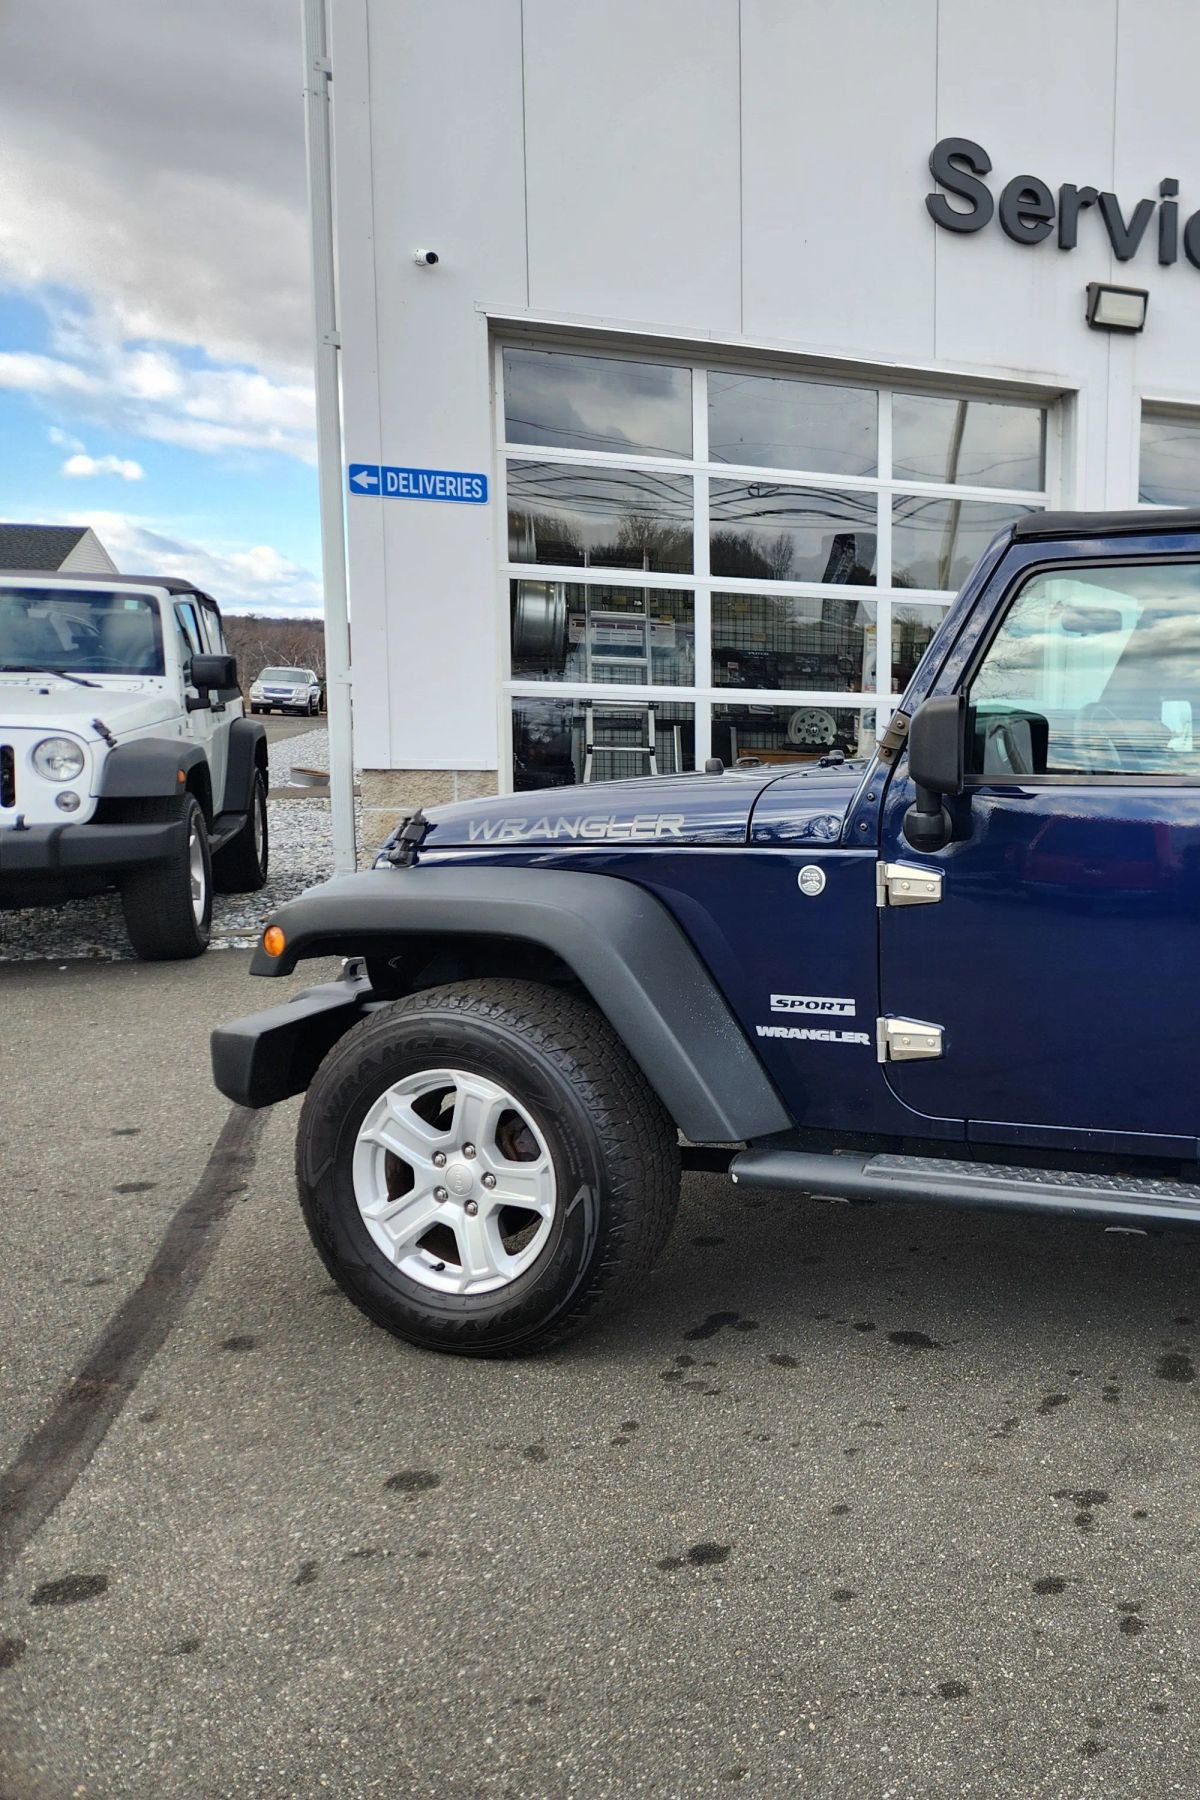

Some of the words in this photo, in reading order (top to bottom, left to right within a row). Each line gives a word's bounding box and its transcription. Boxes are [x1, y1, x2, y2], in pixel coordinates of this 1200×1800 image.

[386, 472, 483, 499] DELIVERIES
[468, 813, 685, 841] WRANGLER
[774, 997, 853, 1013] SPORT
[755, 1025, 871, 1046] WRANGLER
